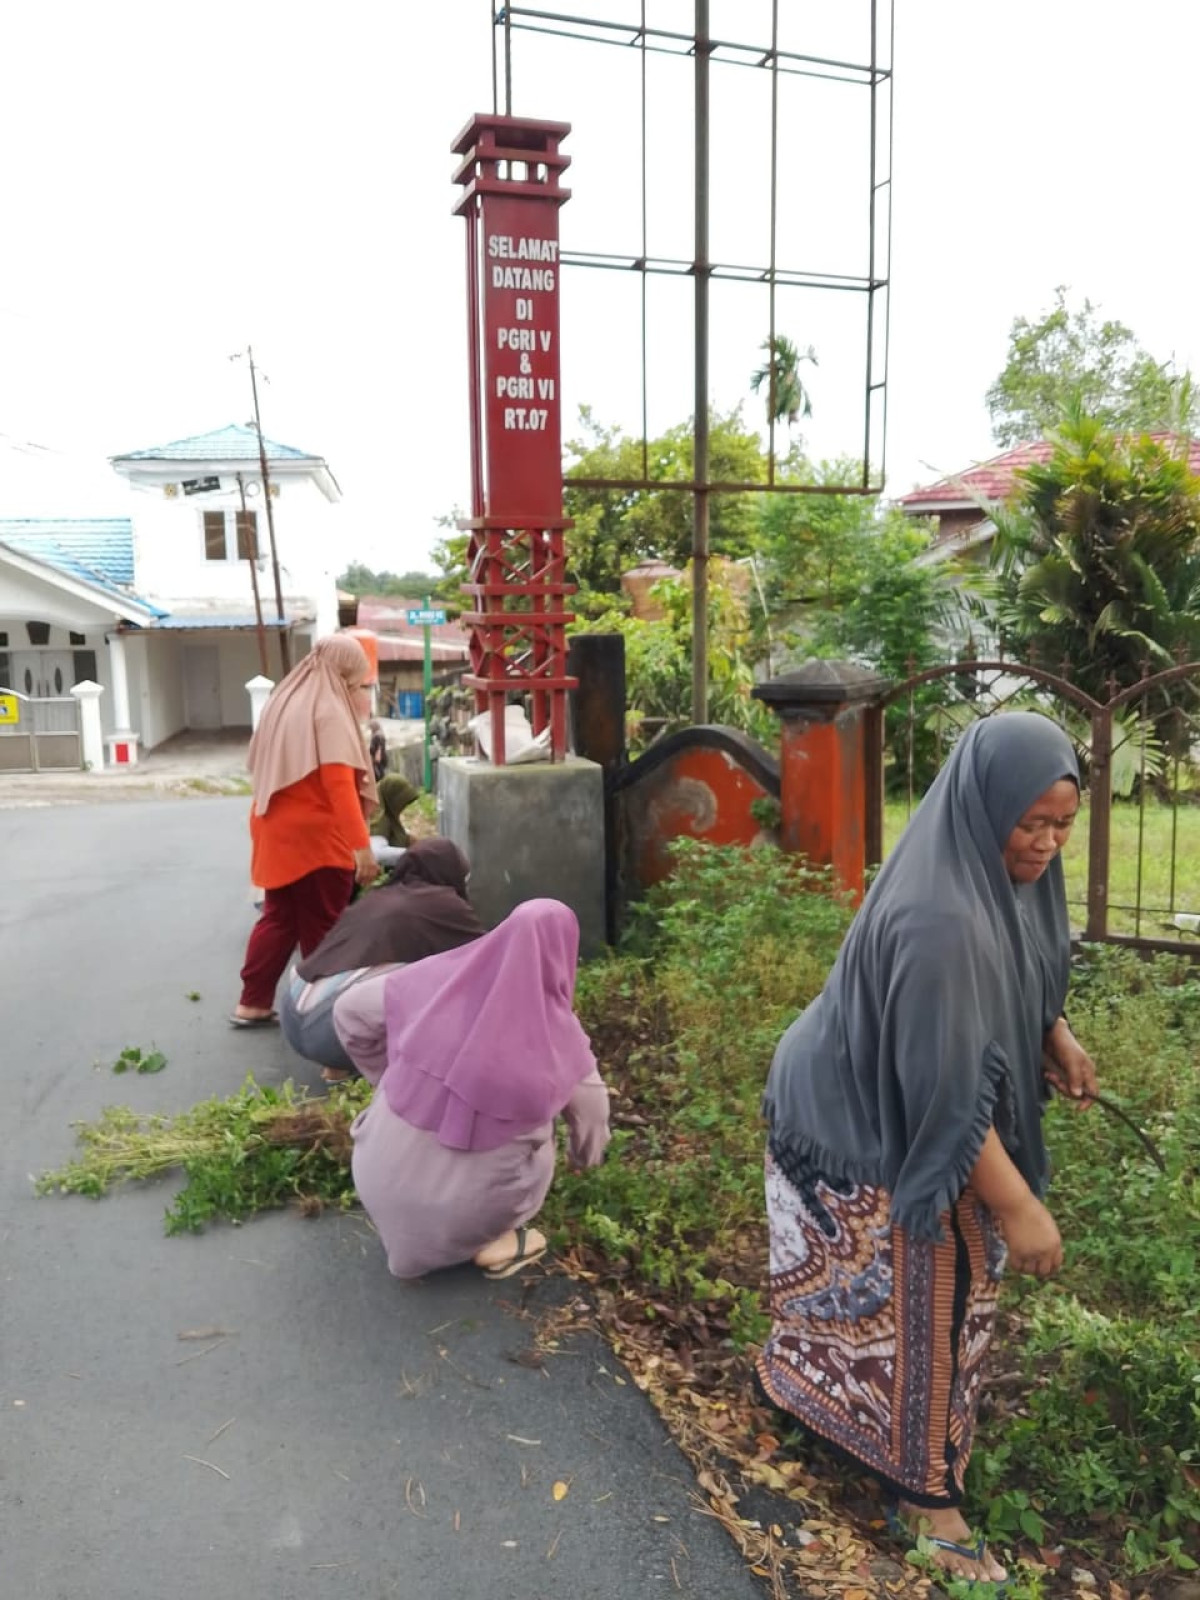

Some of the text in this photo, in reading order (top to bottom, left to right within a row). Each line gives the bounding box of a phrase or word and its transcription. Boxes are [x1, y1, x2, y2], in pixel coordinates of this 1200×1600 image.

[488, 235, 558, 262] SELAMAT
[493, 266, 554, 291] DATANG
[516, 298, 532, 320] DI
[497, 328, 551, 351] PGRI V
[519, 353, 532, 373] &
[496, 376, 554, 400] PGRI VI
[504, 408, 548, 430] RT.07
